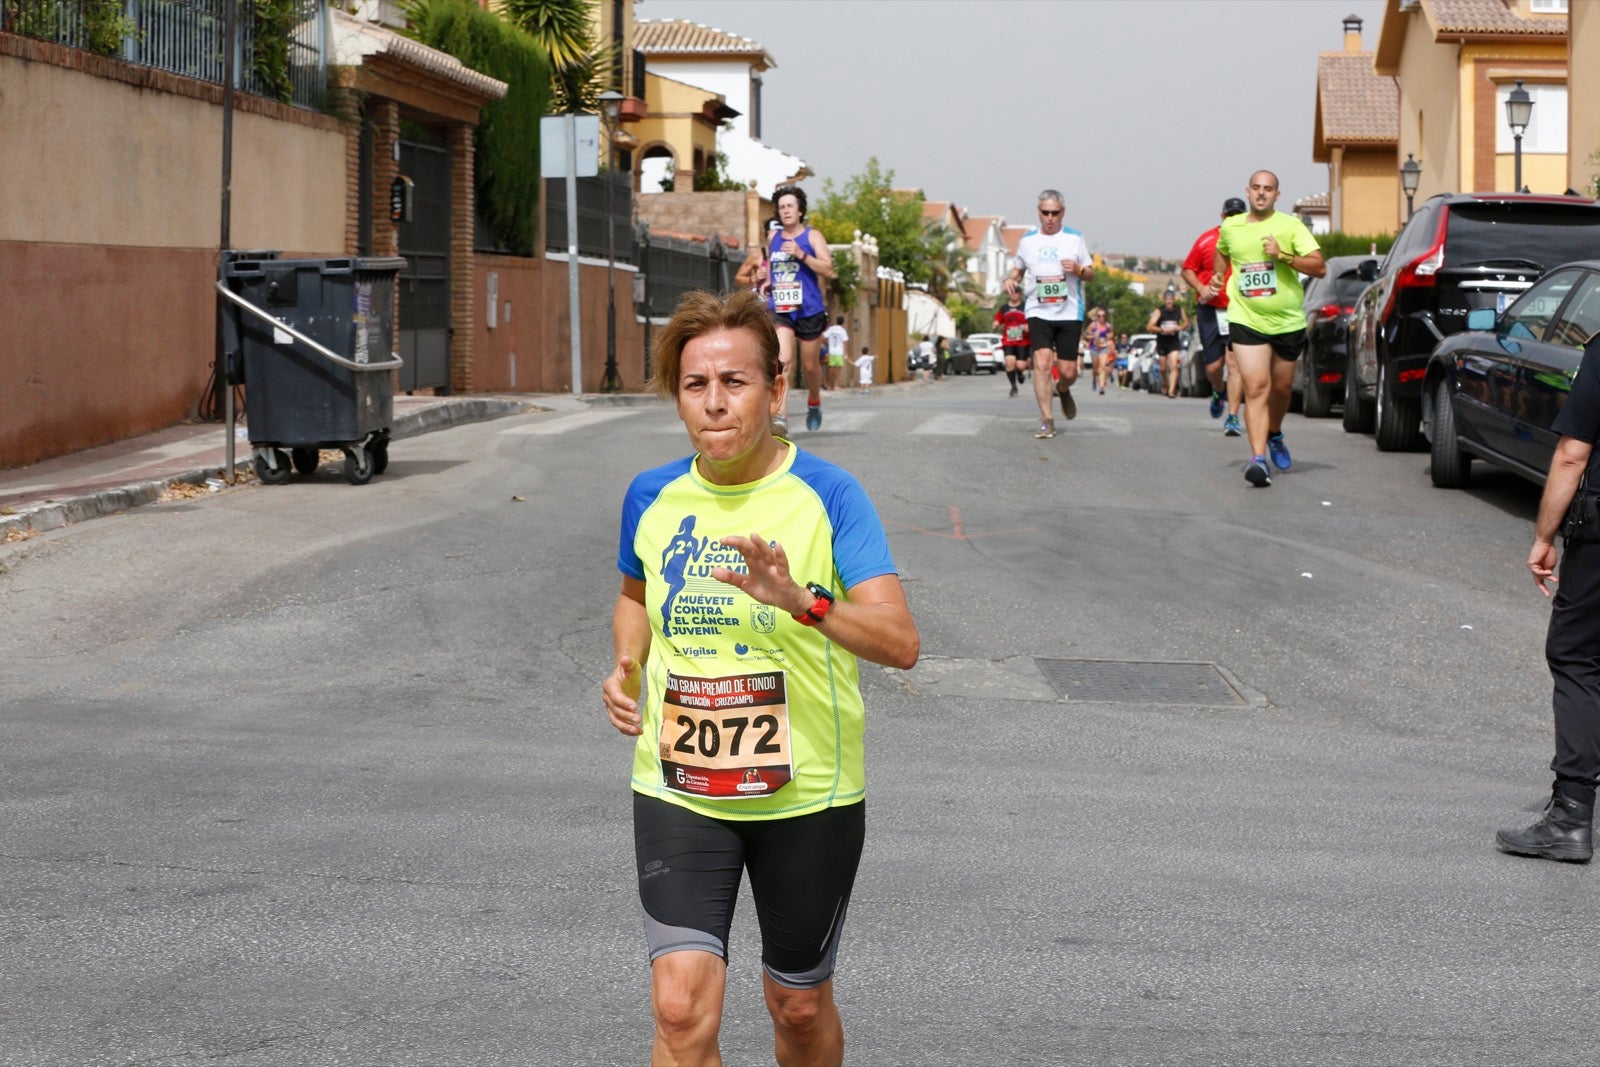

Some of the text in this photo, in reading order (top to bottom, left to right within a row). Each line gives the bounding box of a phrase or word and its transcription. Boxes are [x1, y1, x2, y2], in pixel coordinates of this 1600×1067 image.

[1245, 272, 1270, 287] 360
[1044, 284, 1059, 295] 89
[678, 594, 734, 606] MUÉVETE
[674, 605, 723, 616] CONTRA
[674, 614, 740, 626] EL CÁNCER
[672, 626, 722, 636] JUVENIL
[681, 646, 717, 657] Vigilsa
[680, 680, 701, 694] GRAN
[701, 680, 732, 696] PREMIO
[734, 679, 746, 693] DE
[747, 675, 776, 692] FONDO
[679, 694, 711, 707] DIPUTACIÓN
[715, 694, 754, 707] CRUZCAMPO
[673, 714, 781, 758] 2072
